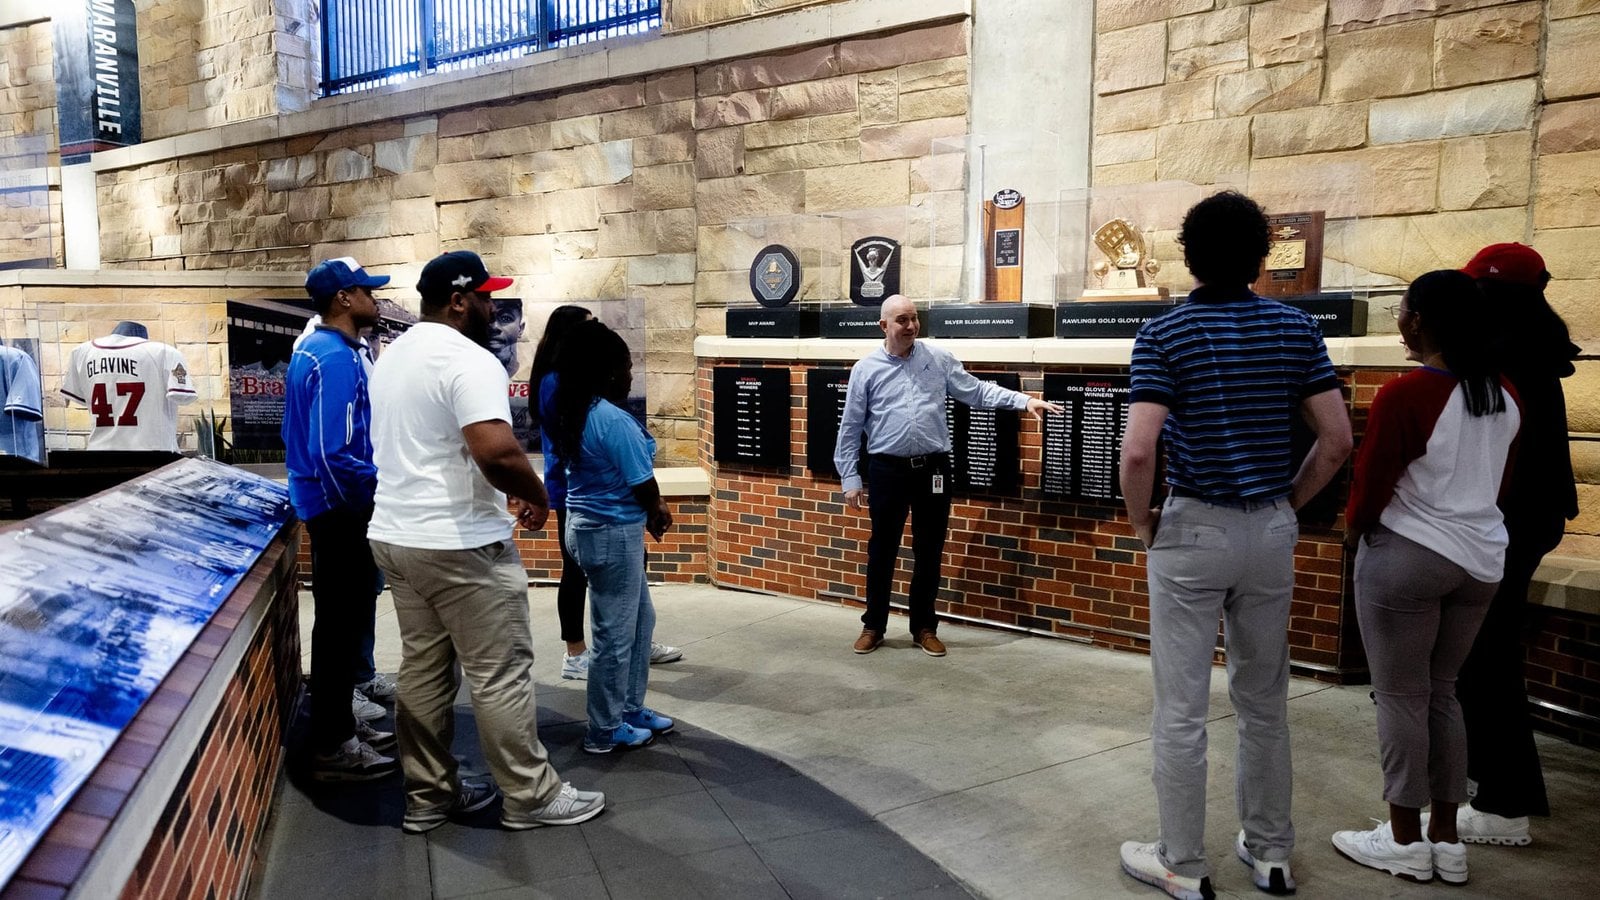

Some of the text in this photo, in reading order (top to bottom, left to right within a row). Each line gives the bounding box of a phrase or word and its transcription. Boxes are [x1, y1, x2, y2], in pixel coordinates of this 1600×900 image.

[87, 357, 139, 379] GLAVINE
[241, 375, 285, 396] Bra
[91, 382, 146, 427] 47
